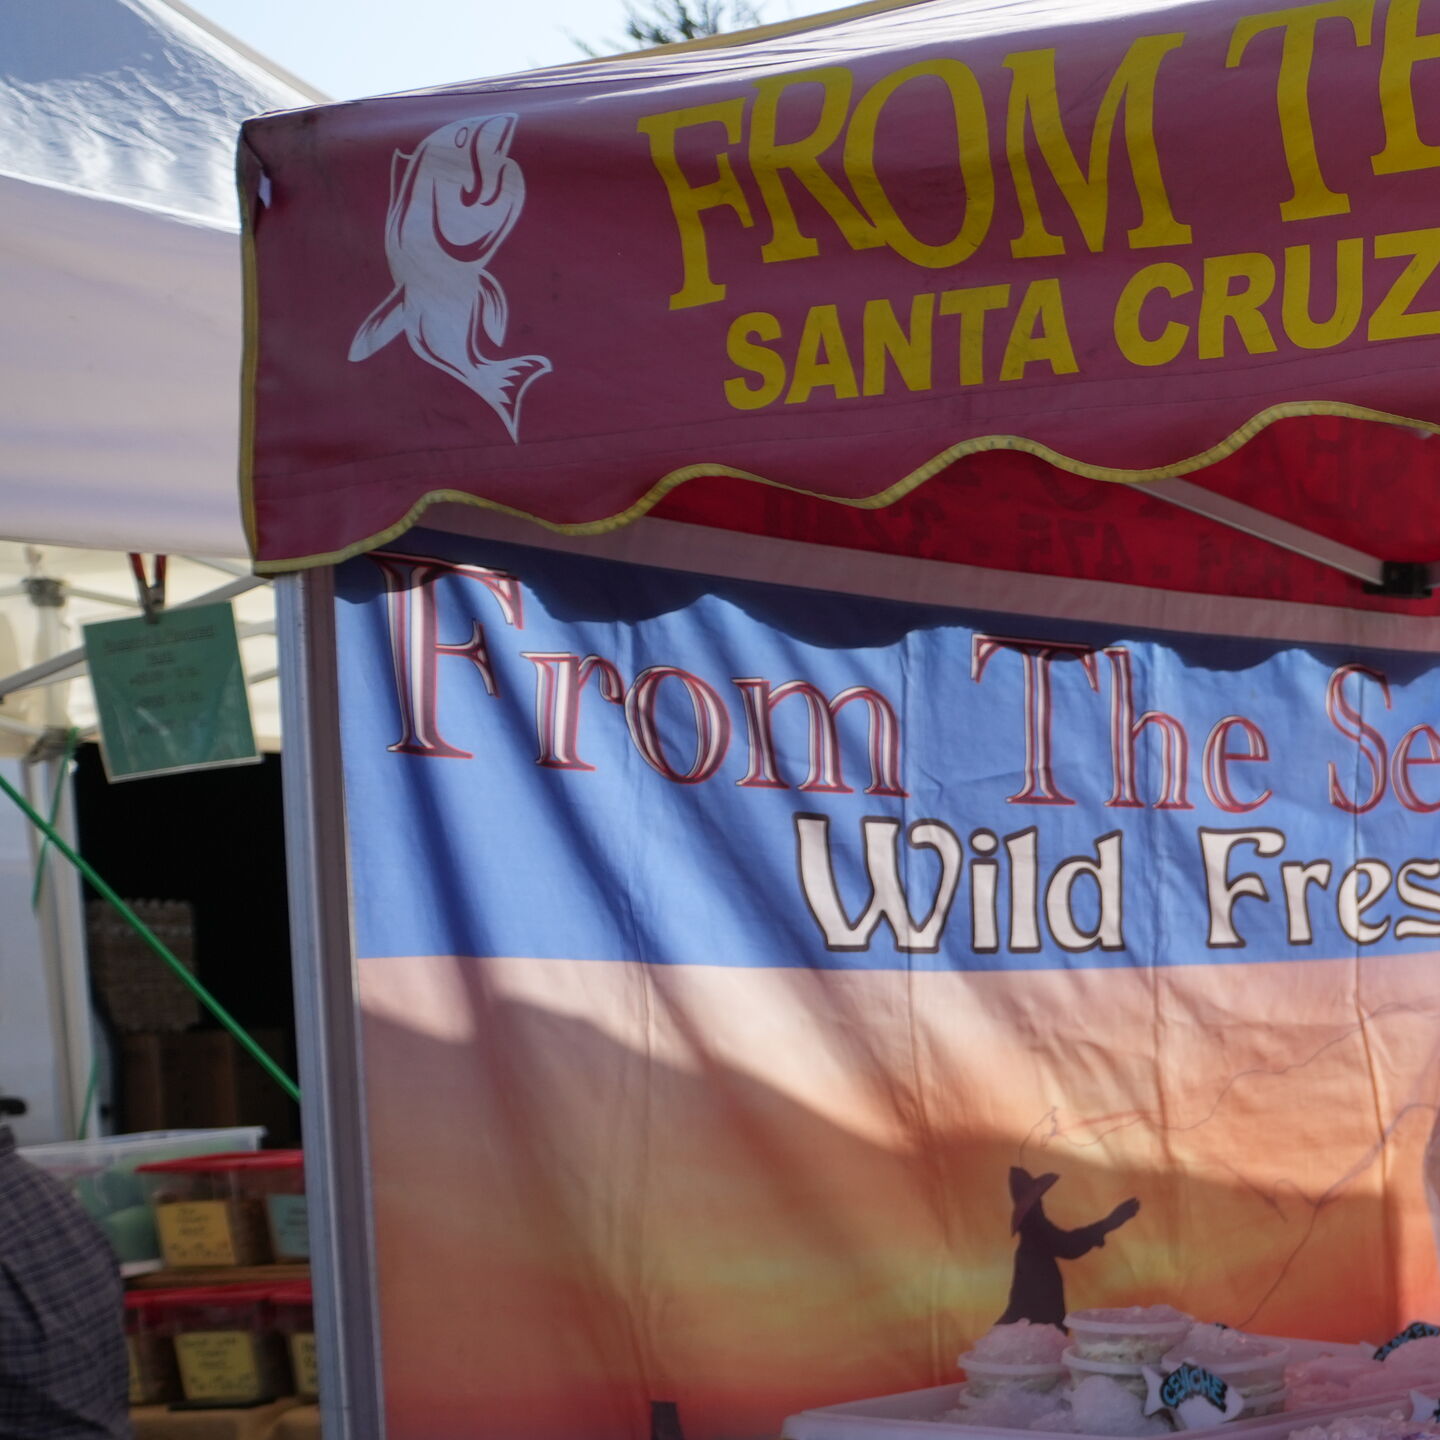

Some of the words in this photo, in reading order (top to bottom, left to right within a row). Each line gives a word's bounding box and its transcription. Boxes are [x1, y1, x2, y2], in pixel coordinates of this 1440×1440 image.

[636, 32, 1195, 312] FROM
[722, 274, 1080, 412] SANTA
[368, 548, 910, 798] From
[970, 630, 1273, 813] The
[794, 812, 1126, 954] Wild
[1160, 1367, 1229, 1411] CEVICHE
